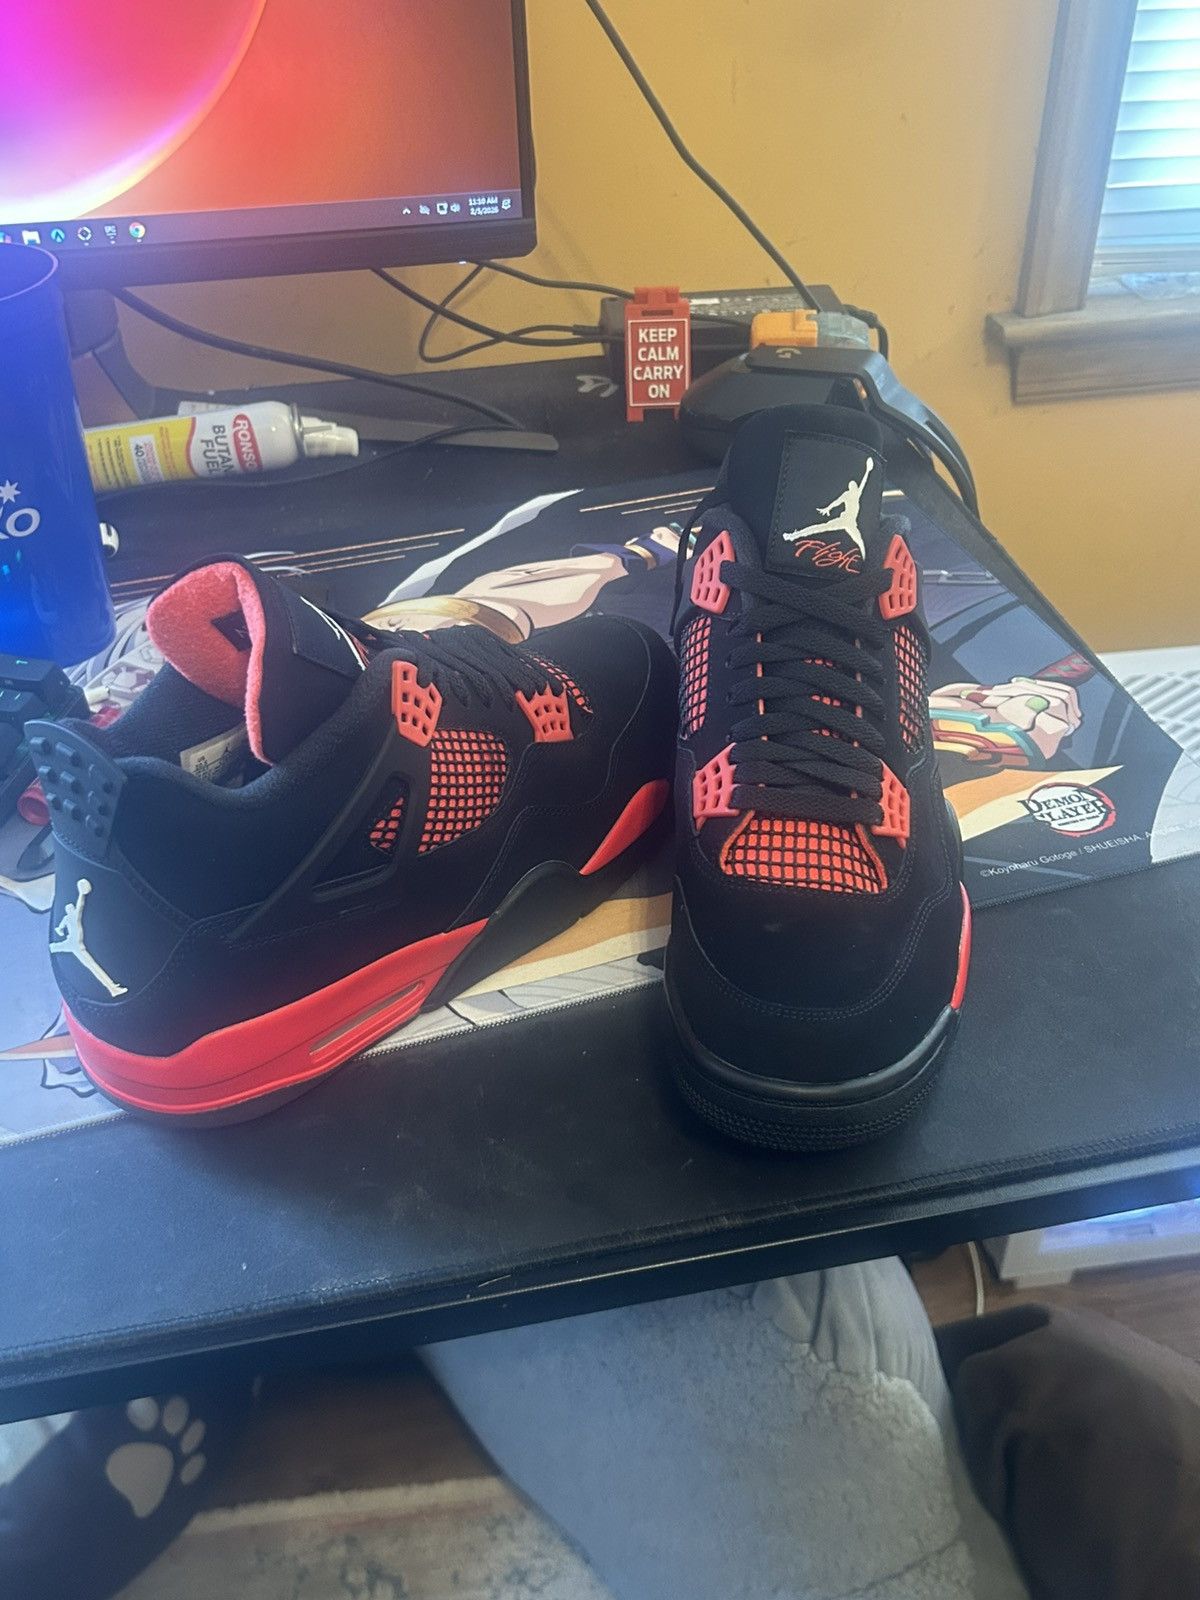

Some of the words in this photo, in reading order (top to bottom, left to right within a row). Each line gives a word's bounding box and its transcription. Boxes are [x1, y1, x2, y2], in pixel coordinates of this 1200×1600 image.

[486, 196, 498, 205] AM
[638, 327, 678, 343] KEEP
[637, 346, 680, 361] CALM
[633, 364, 684, 381] CARRY
[648, 384, 671, 399] ON
[212, 424, 235, 473] BUTAN
[233, 420, 257, 469] RONSO
[1017, 789, 1088, 814] DEMON
[1039, 850, 1078, 865] Gotoge
